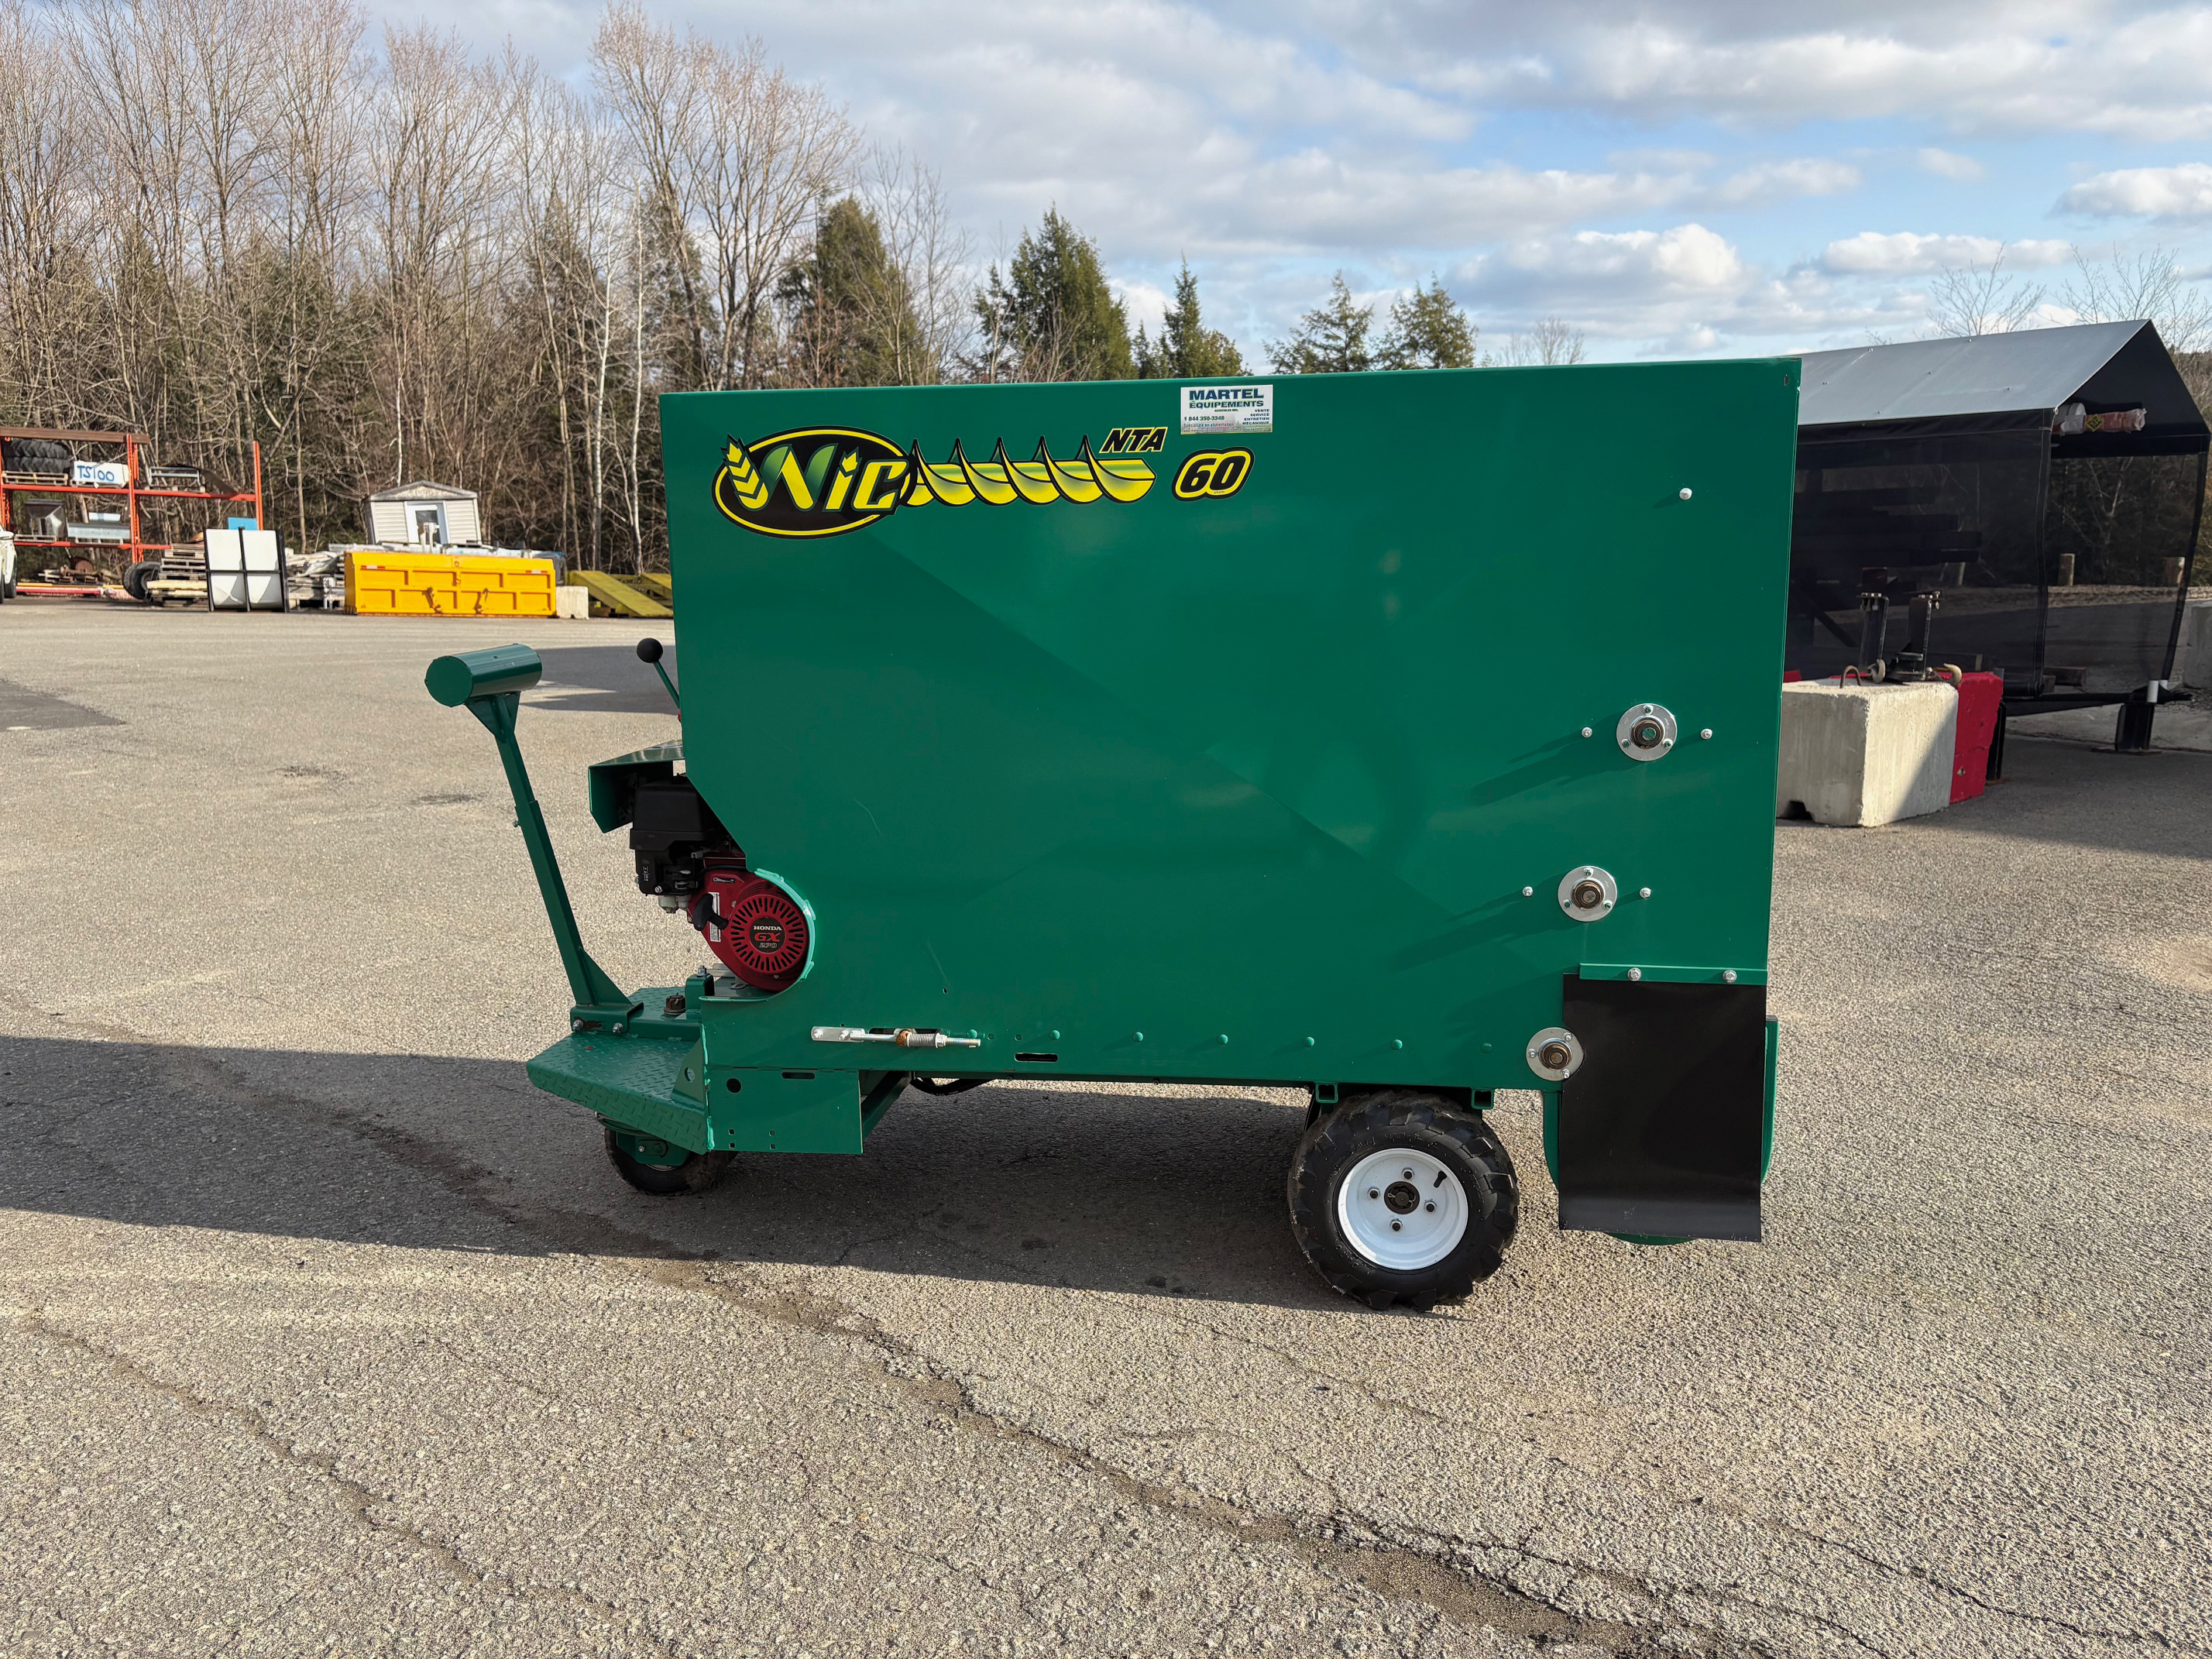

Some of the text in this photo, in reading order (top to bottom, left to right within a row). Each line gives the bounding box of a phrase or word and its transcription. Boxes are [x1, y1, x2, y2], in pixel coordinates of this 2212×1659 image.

[1190, 389, 1264, 400] MARTEL
[1189, 400, 1264, 409] ÉQUIPEMENTS
[1099, 427, 1168, 453] NTA
[1180, 455, 1246, 493] 60
[754, 932, 780, 942] GX
